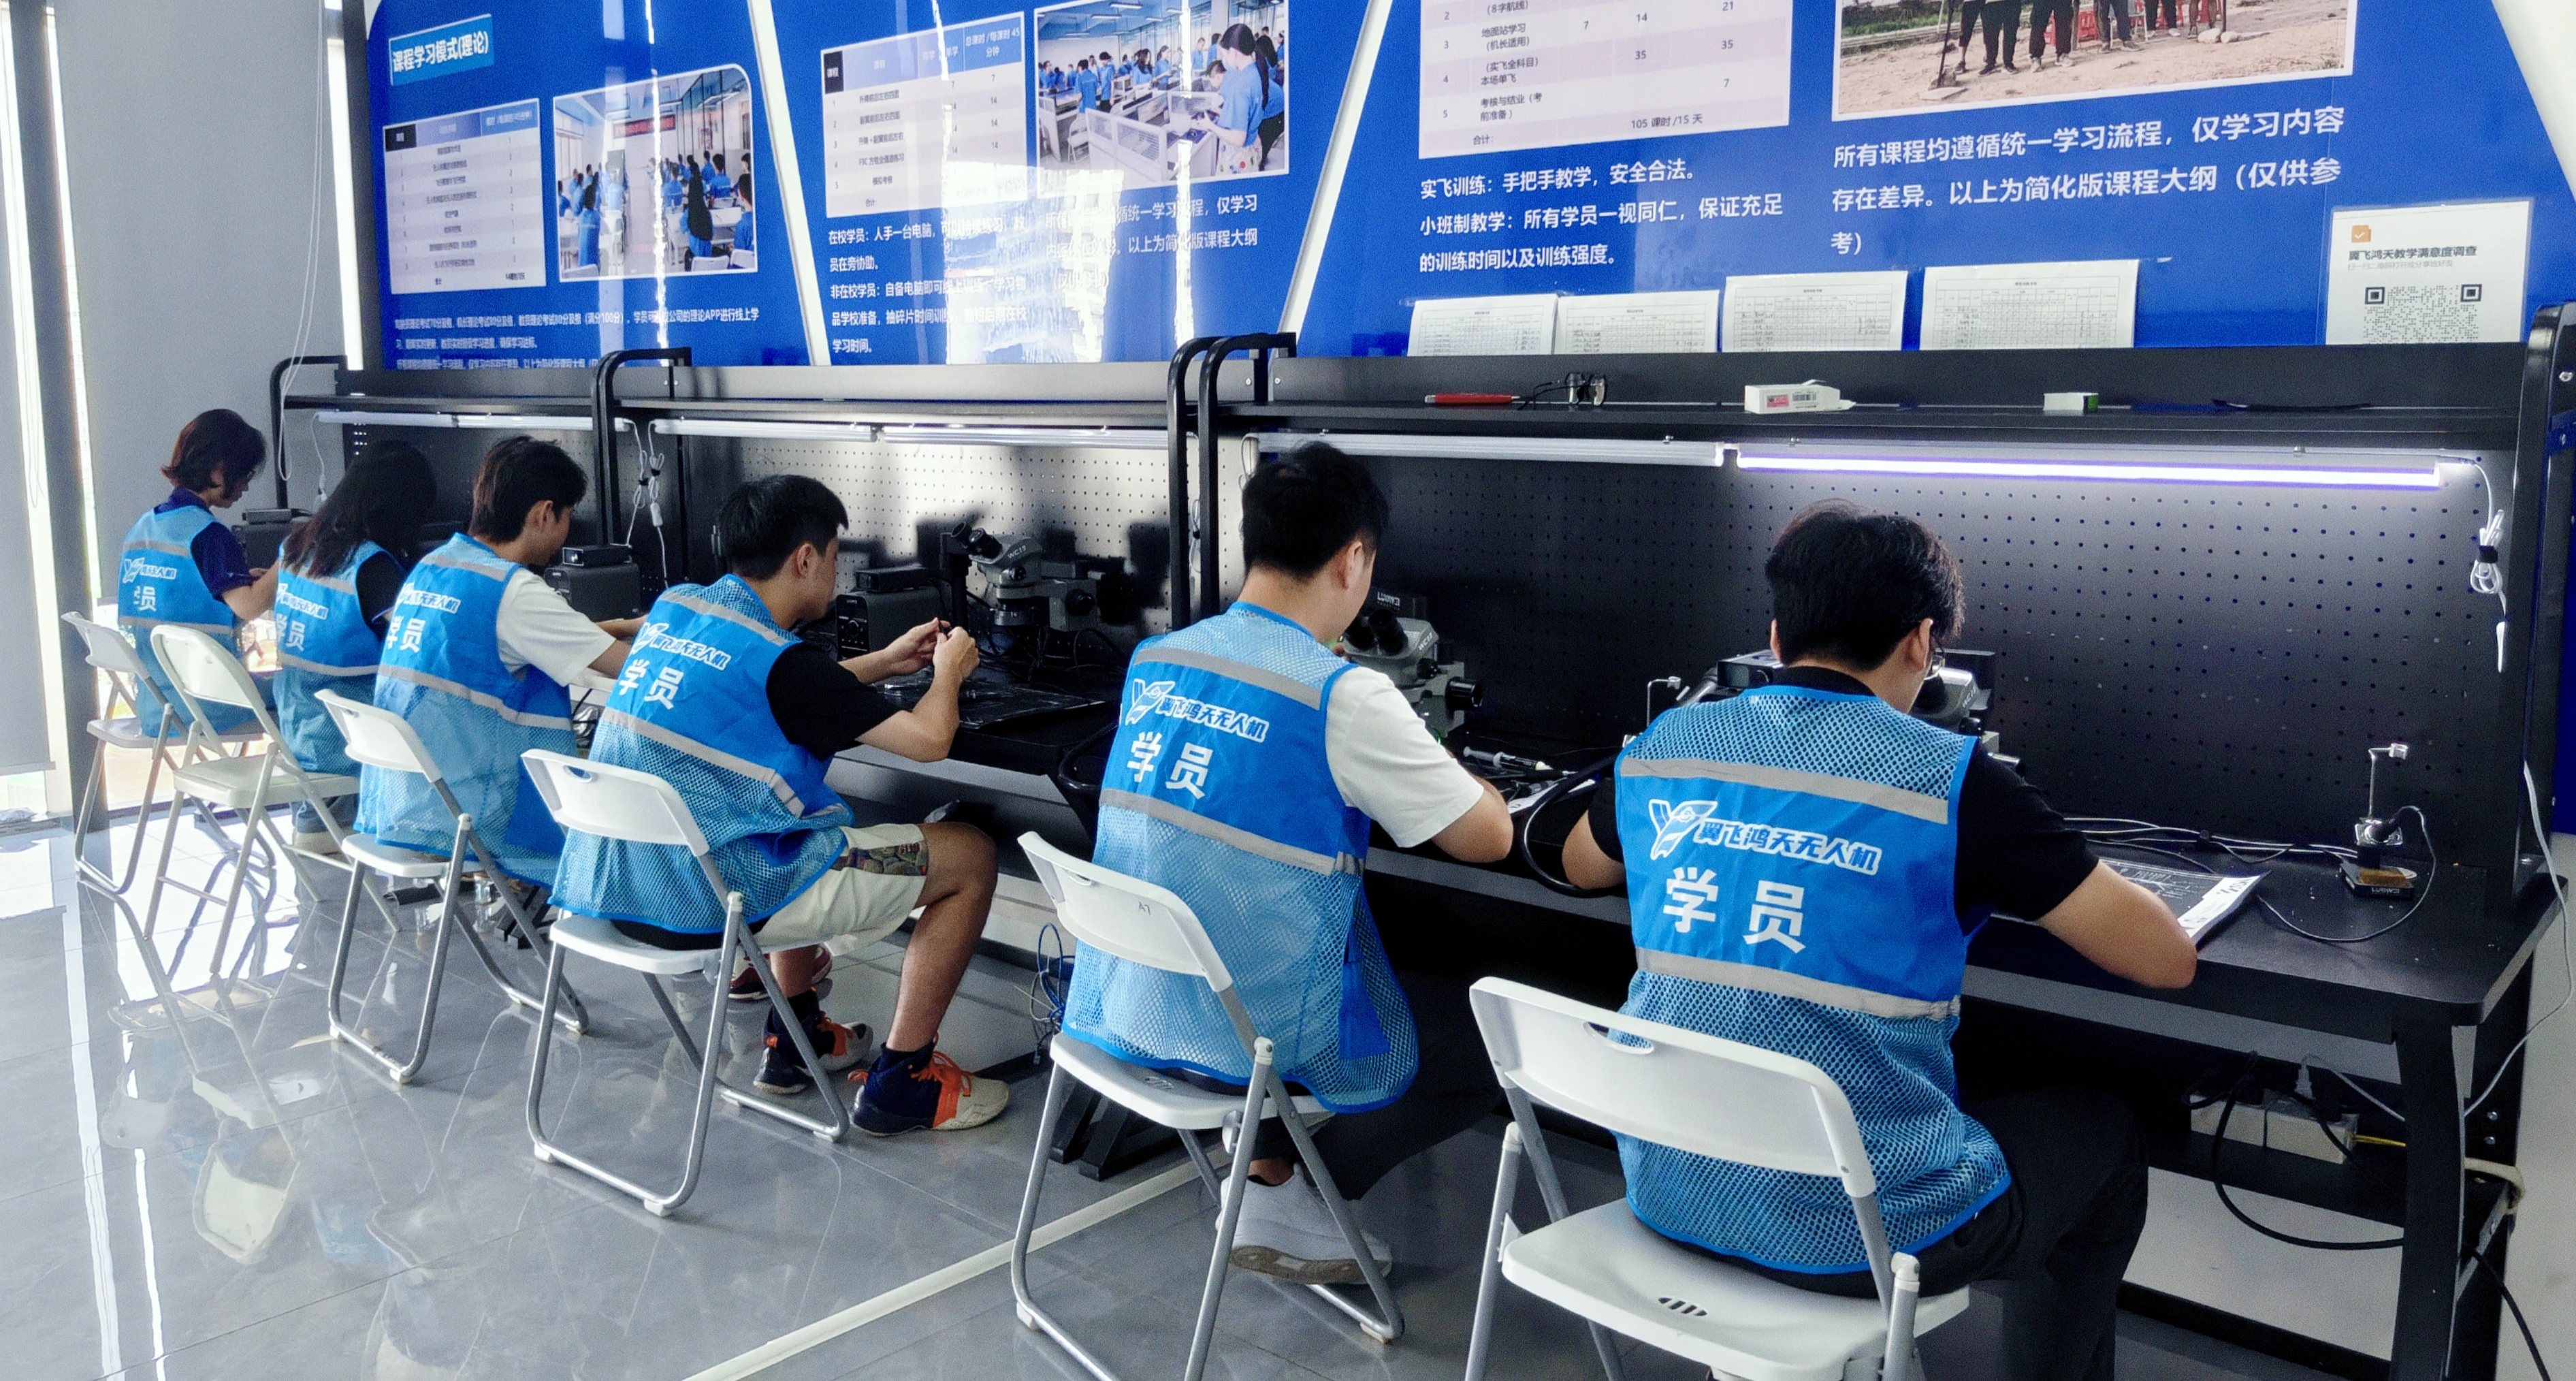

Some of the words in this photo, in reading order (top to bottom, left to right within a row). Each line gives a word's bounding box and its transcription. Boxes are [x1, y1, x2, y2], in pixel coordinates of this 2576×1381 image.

[1443, 40, 1449, 49] 3
[1481, 23, 1526, 37] 地面站学习
[1583, 20, 1590, 29] 7
[1636, 14, 1647, 22] 14
[1722, 1, 1733, 11] 21
[1444, 12, 1449, 20] 2
[393, 31, 489, 72] 课程学习模式(理论)
[1486, 57, 1539, 72] （实飞全科目）
[1635, 50, 1647, 60] 35
[1721, 39, 1733, 50] 35
[1487, 37, 1530, 51] （机长适用）
[992, 74, 996, 82] 7
[1481, 73, 1517, 86] 本场单飞
[991, 97, 997, 105] 14
[1443, 110, 1448, 118] 5
[1724, 78, 1729, 88] 7
[991, 119, 998, 127] 14
[1631, 118, 1648, 129] 105
[1692, 113, 1703, 124] 天
[1833, 106, 2345, 168] 所有课程均遵循统一学习流程，仅学习内容
[1421, 158, 1694, 200] 实飞训练：手把手教学，安全合法。
[1833, 157, 2342, 212] 存在差异。以上为简化版课程大纲（仅供参
[1420, 193, 1783, 236] 小班制教学：所有学员一视同仁，保证充足
[830, 255, 878, 272] 员在旁协助。
[1419, 243, 1615, 273] 的训练时间以及训练强度。
[833, 338, 872, 353] 学习时间。
[386, 615, 426, 654] 学员
[619, 658, 684, 710] 学员
[1156, 695, 1269, 743] 翼飞鸿天无人机
[1127, 731, 1213, 800] 学员
[1694, 819, 1882, 874] 翼飞鸿天无人机
[1663, 867, 1806, 955] 学员
